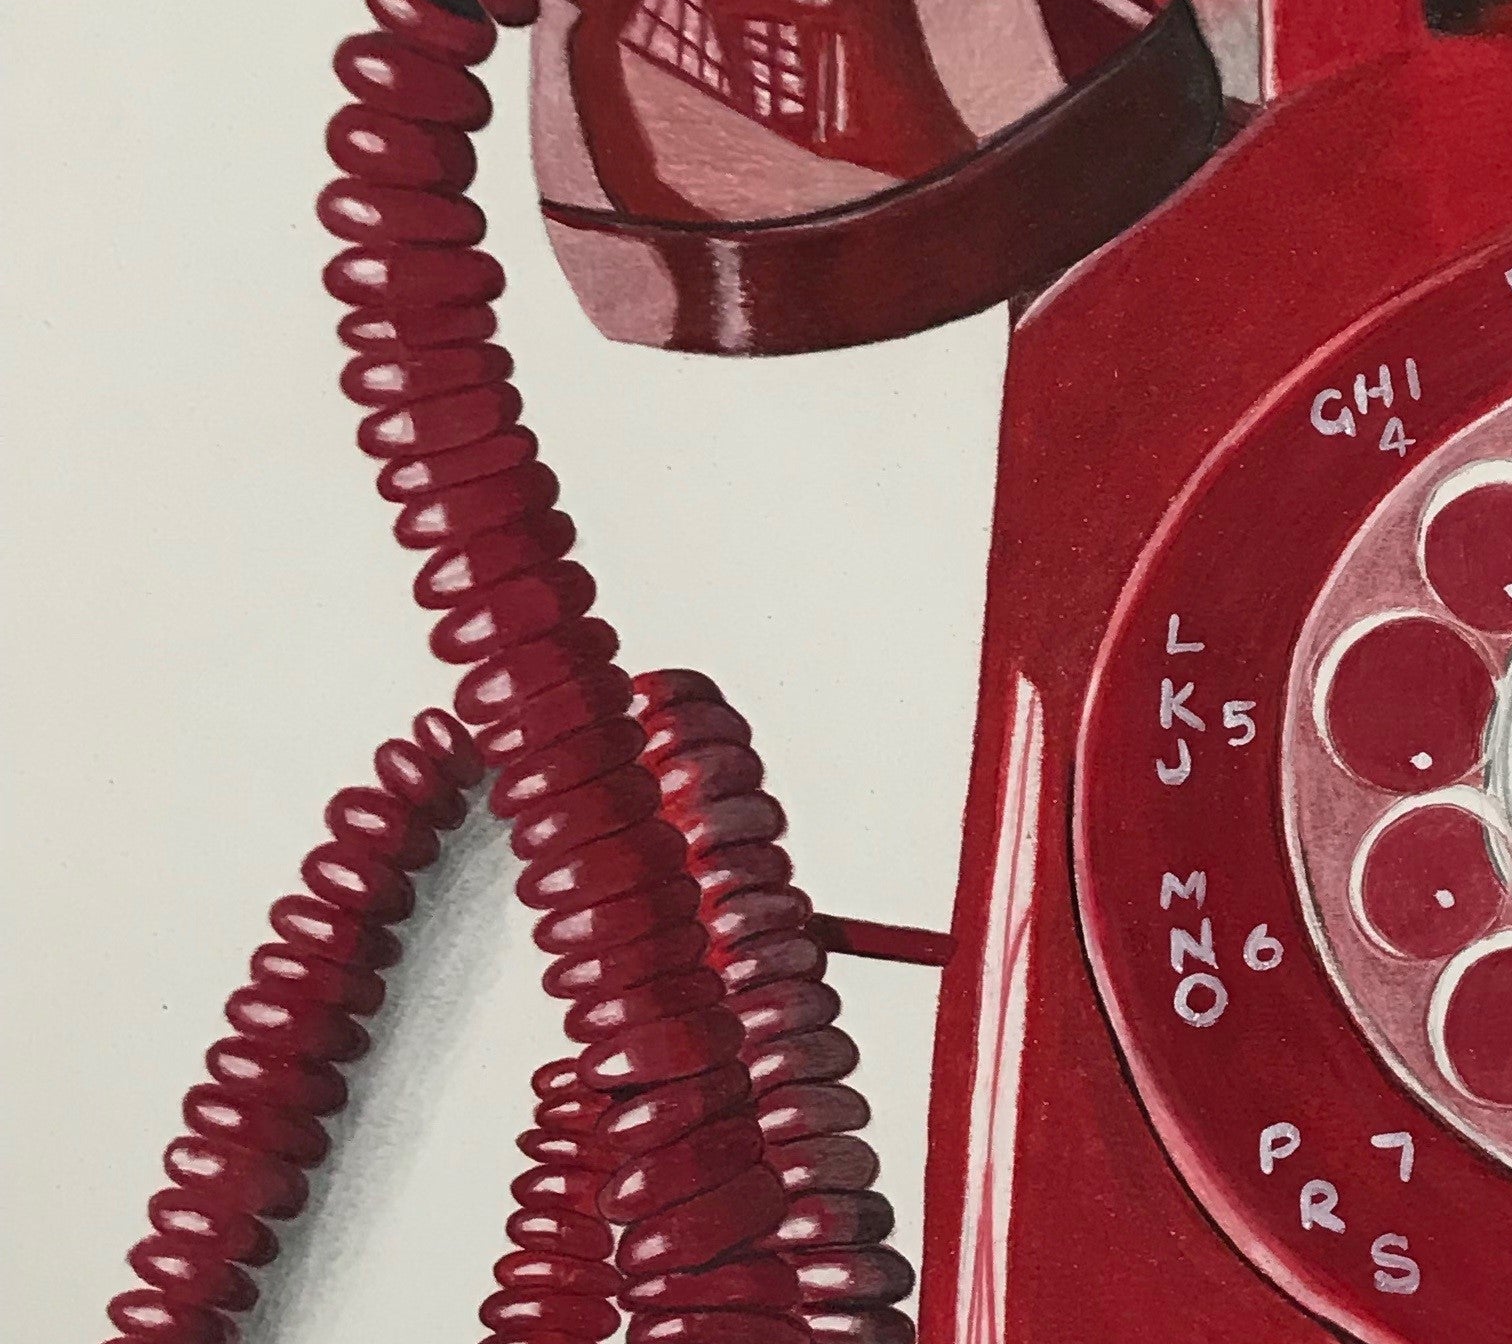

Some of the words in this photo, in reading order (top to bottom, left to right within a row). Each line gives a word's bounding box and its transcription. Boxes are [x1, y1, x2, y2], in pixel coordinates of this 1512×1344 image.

[1309, 356, 1422, 439] GHI
[1377, 416, 1417, 458] 4
[1222, 699, 1257, 747] 5
[1242, 923, 1285, 971] 6
[1370, 1131, 1415, 1183] 7
